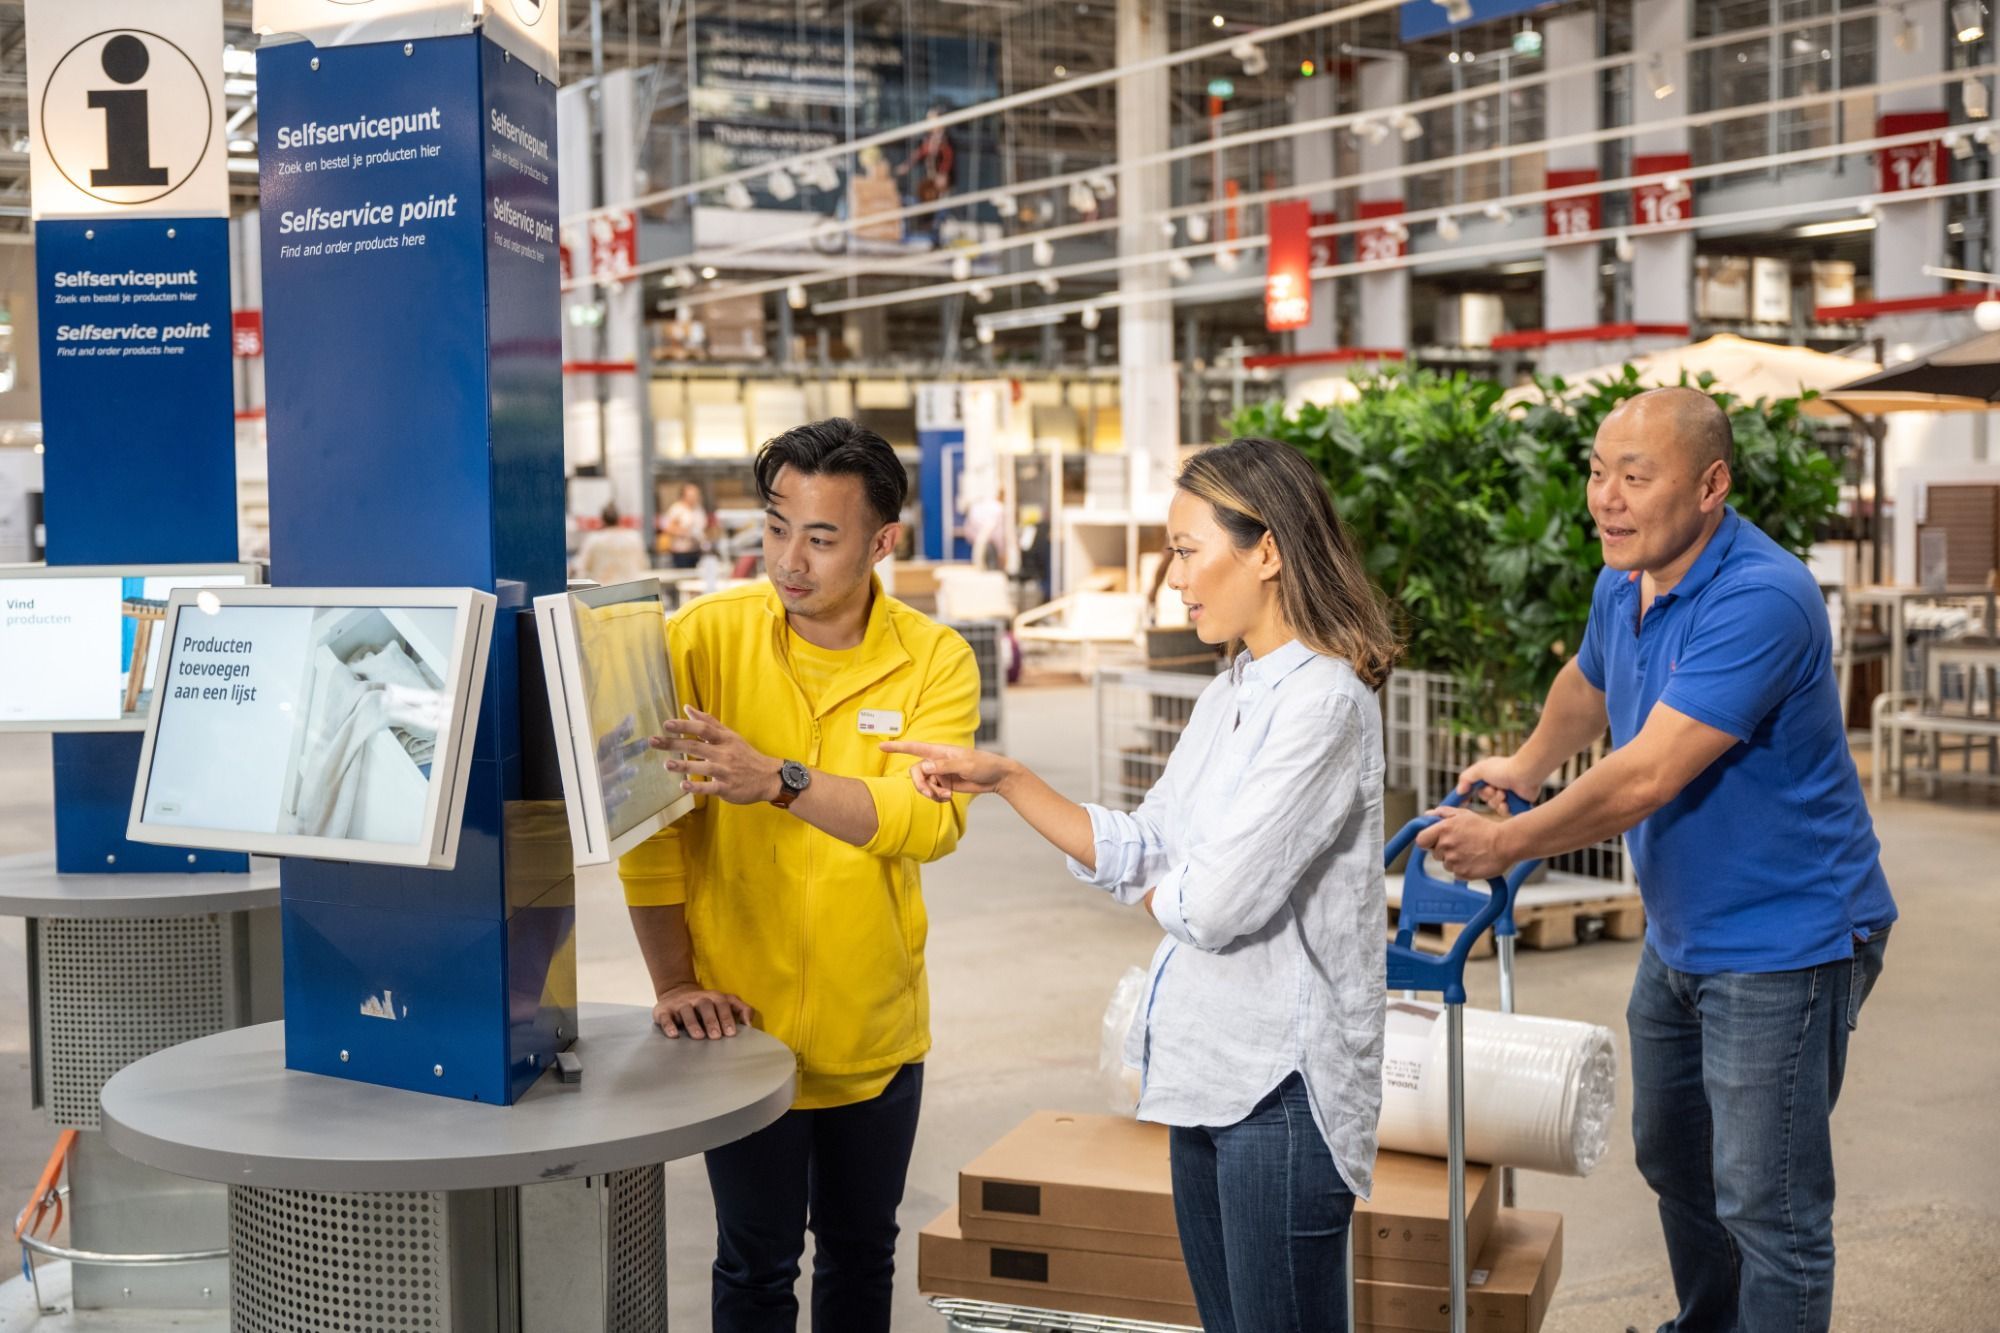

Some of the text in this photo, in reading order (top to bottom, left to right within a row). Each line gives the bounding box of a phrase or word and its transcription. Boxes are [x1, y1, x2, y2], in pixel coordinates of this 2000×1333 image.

[277, 106, 441, 149] Selfservicepunt
[490, 108, 548, 161] Selfservicepunt
[278, 144, 441, 176] Zoek en bestel je producten hier
[1891, 157, 1936, 190] 14
[279, 193, 458, 234] Selfservice point
[493, 196, 554, 244] Selfservice point
[1641, 194, 1682, 225] 16
[1551, 206, 1591, 238] 18
[280, 233, 426, 259] Find and order products here
[54, 269, 198, 289] Selfservicepunt
[55, 292, 198, 304] Zoek en bestel je producten hier
[56, 322, 212, 342] Selfservice point
[57, 345, 185, 357] Find and order products here
[6, 598, 35, 610] Vind
[6, 613, 72, 627] producten
[182, 636, 253, 654] Producten
[179, 660, 250, 681] toevoegen
[174, 684, 257, 706] aan een lijst
